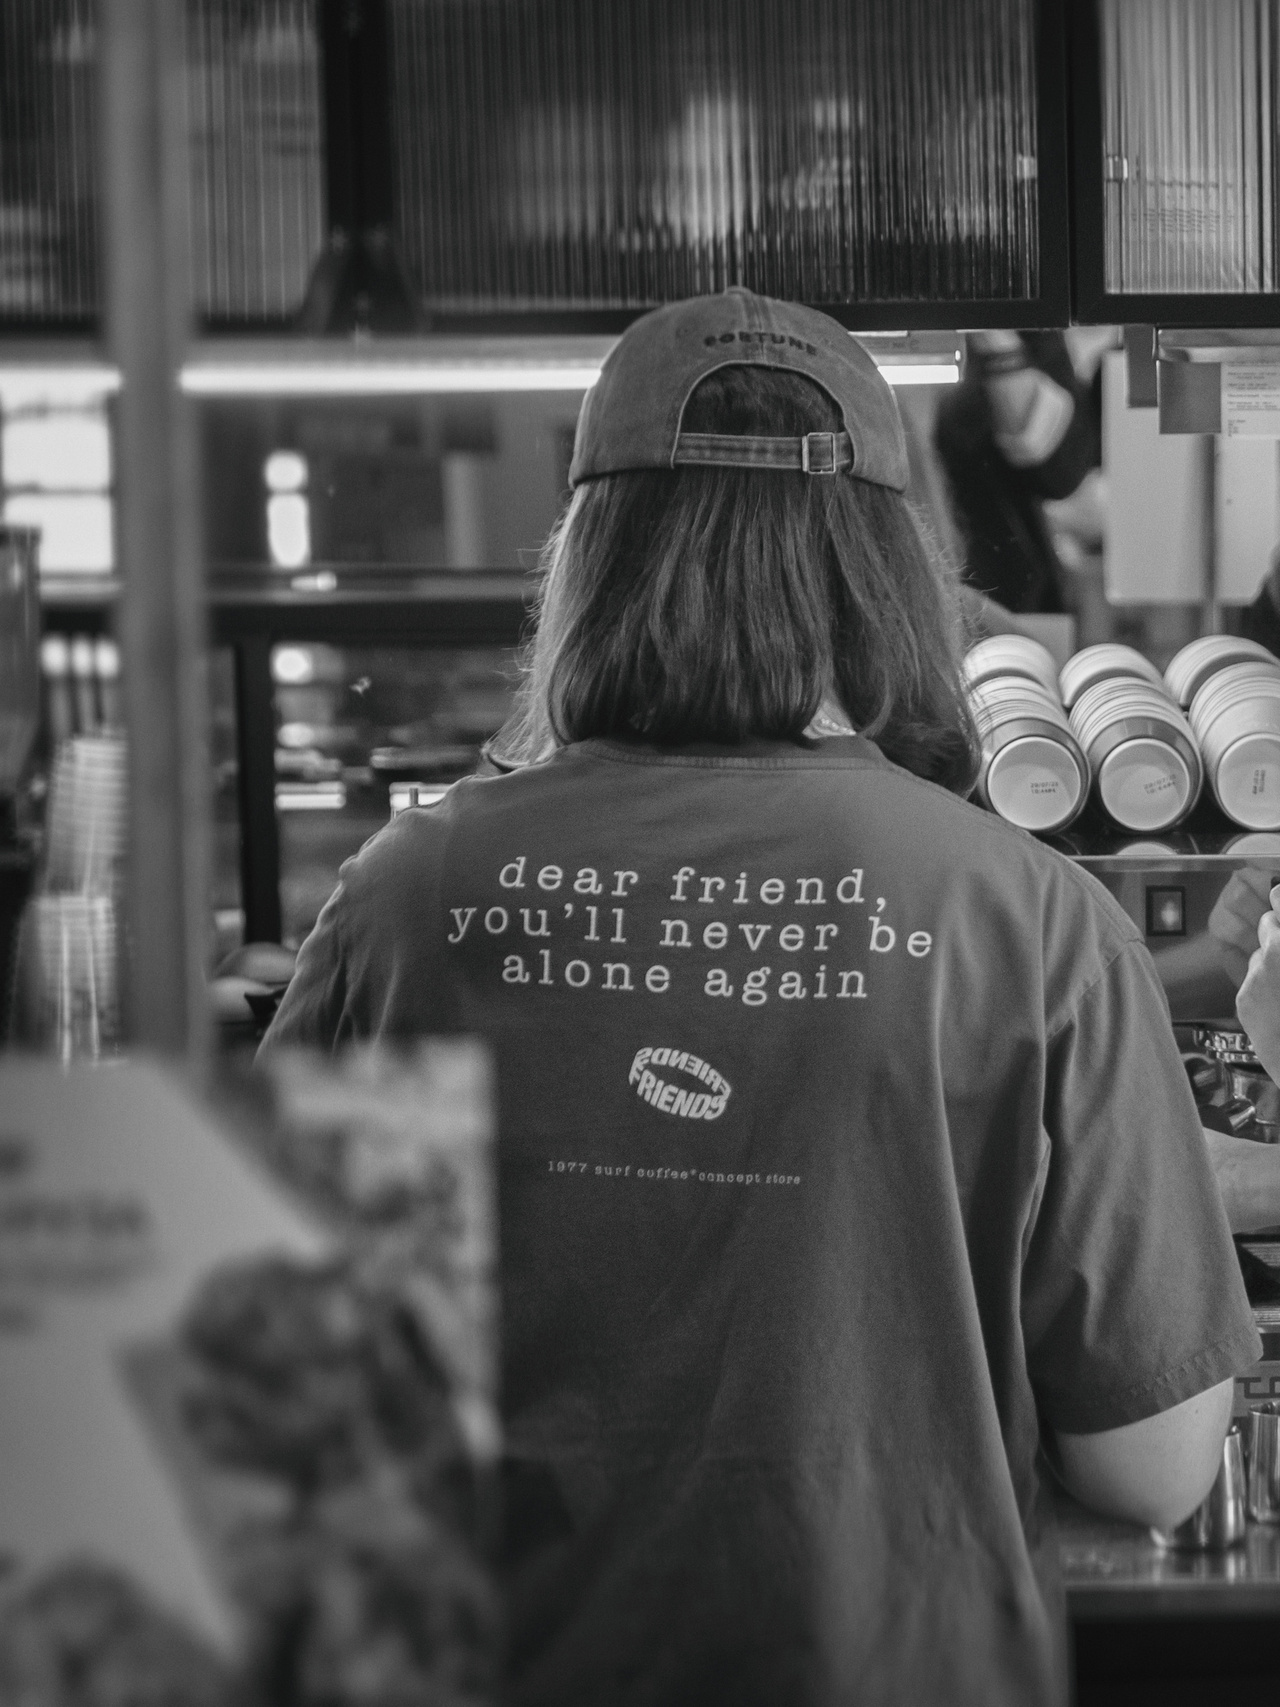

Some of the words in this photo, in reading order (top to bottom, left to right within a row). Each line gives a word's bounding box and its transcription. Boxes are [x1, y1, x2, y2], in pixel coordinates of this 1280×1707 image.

[498, 856, 640, 896] dear
[669, 866, 887, 912] friend,
[447, 902, 627, 943] you'll
[659, 917, 839, 952] never
[868, 915, 933, 957] be
[501, 949, 671, 992] alone
[703, 963, 868, 1006] again
[628, 1062, 728, 1120] FRIENDS
[548, 1160, 588, 1173] 1977
[594, 1164, 631, 1177] surf
[764, 1173, 801, 1185] store
